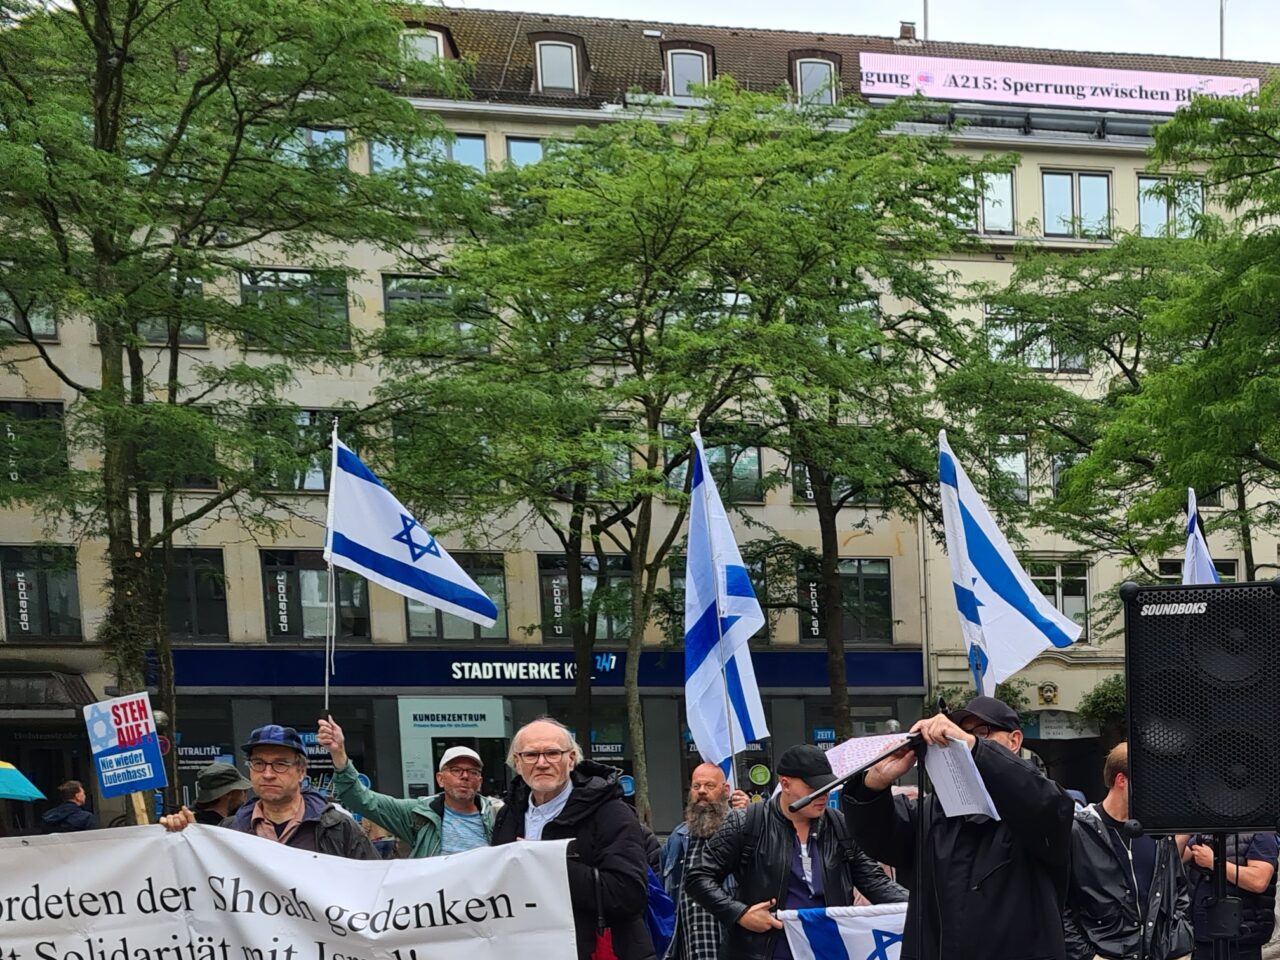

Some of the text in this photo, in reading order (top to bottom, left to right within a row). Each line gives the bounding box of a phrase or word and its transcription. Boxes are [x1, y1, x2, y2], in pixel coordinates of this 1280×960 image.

[947, 74, 998, 91] A215:
[1002, 76, 1086, 99] Sperrung
[1090, 84, 1169, 101] zwischen
[17, 572, 30, 631] dataport
[275, 574, 288, 632] dataport
[552, 578, 563, 635] dtaport
[1140, 602, 1208, 616] SOUNDBOKS
[451, 662, 561, 680] STADTWERKE
[111, 699, 149, 726] STEH
[412, 713, 487, 722] KUNDENZENTRUM
[101, 752, 143, 771] Nie wieder
[0, 883, 126, 921] rdeten
[136, 876, 196, 914] der
[207, 875, 319, 923] Shoah
[324, 888, 515, 937] gedenken
